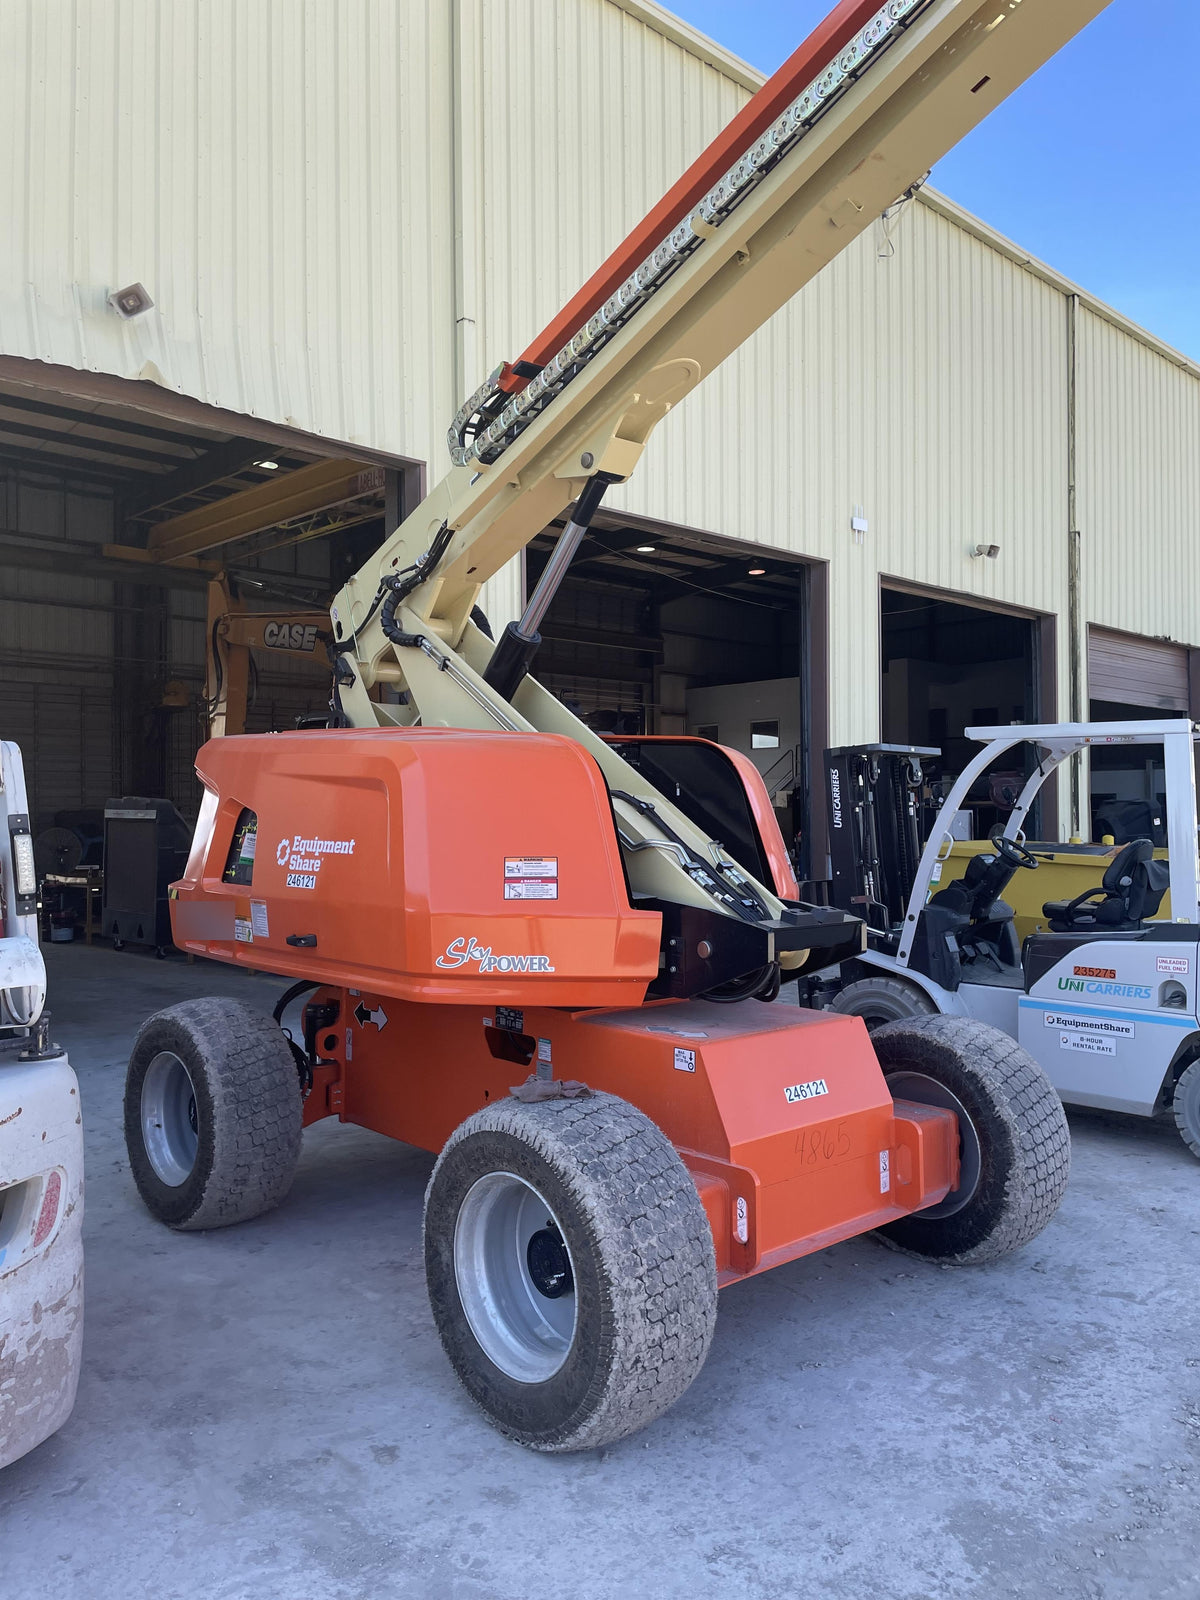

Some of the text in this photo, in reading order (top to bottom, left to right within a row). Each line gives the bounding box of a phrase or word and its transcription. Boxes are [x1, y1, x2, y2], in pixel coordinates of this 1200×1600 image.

[264, 621, 318, 652] CASE
[292, 835, 355, 856] Equipment
[289, 854, 321, 872] Share
[287, 874, 315, 888] 246121
[1074, 966, 1116, 979] 235275
[1056, 1017, 1131, 1034] EquipmentShare
[1072, 1042, 1113, 1053] RENTAL RATE
[785, 1080, 827, 1102] 246121
[794, 1121, 851, 1166] 4865
